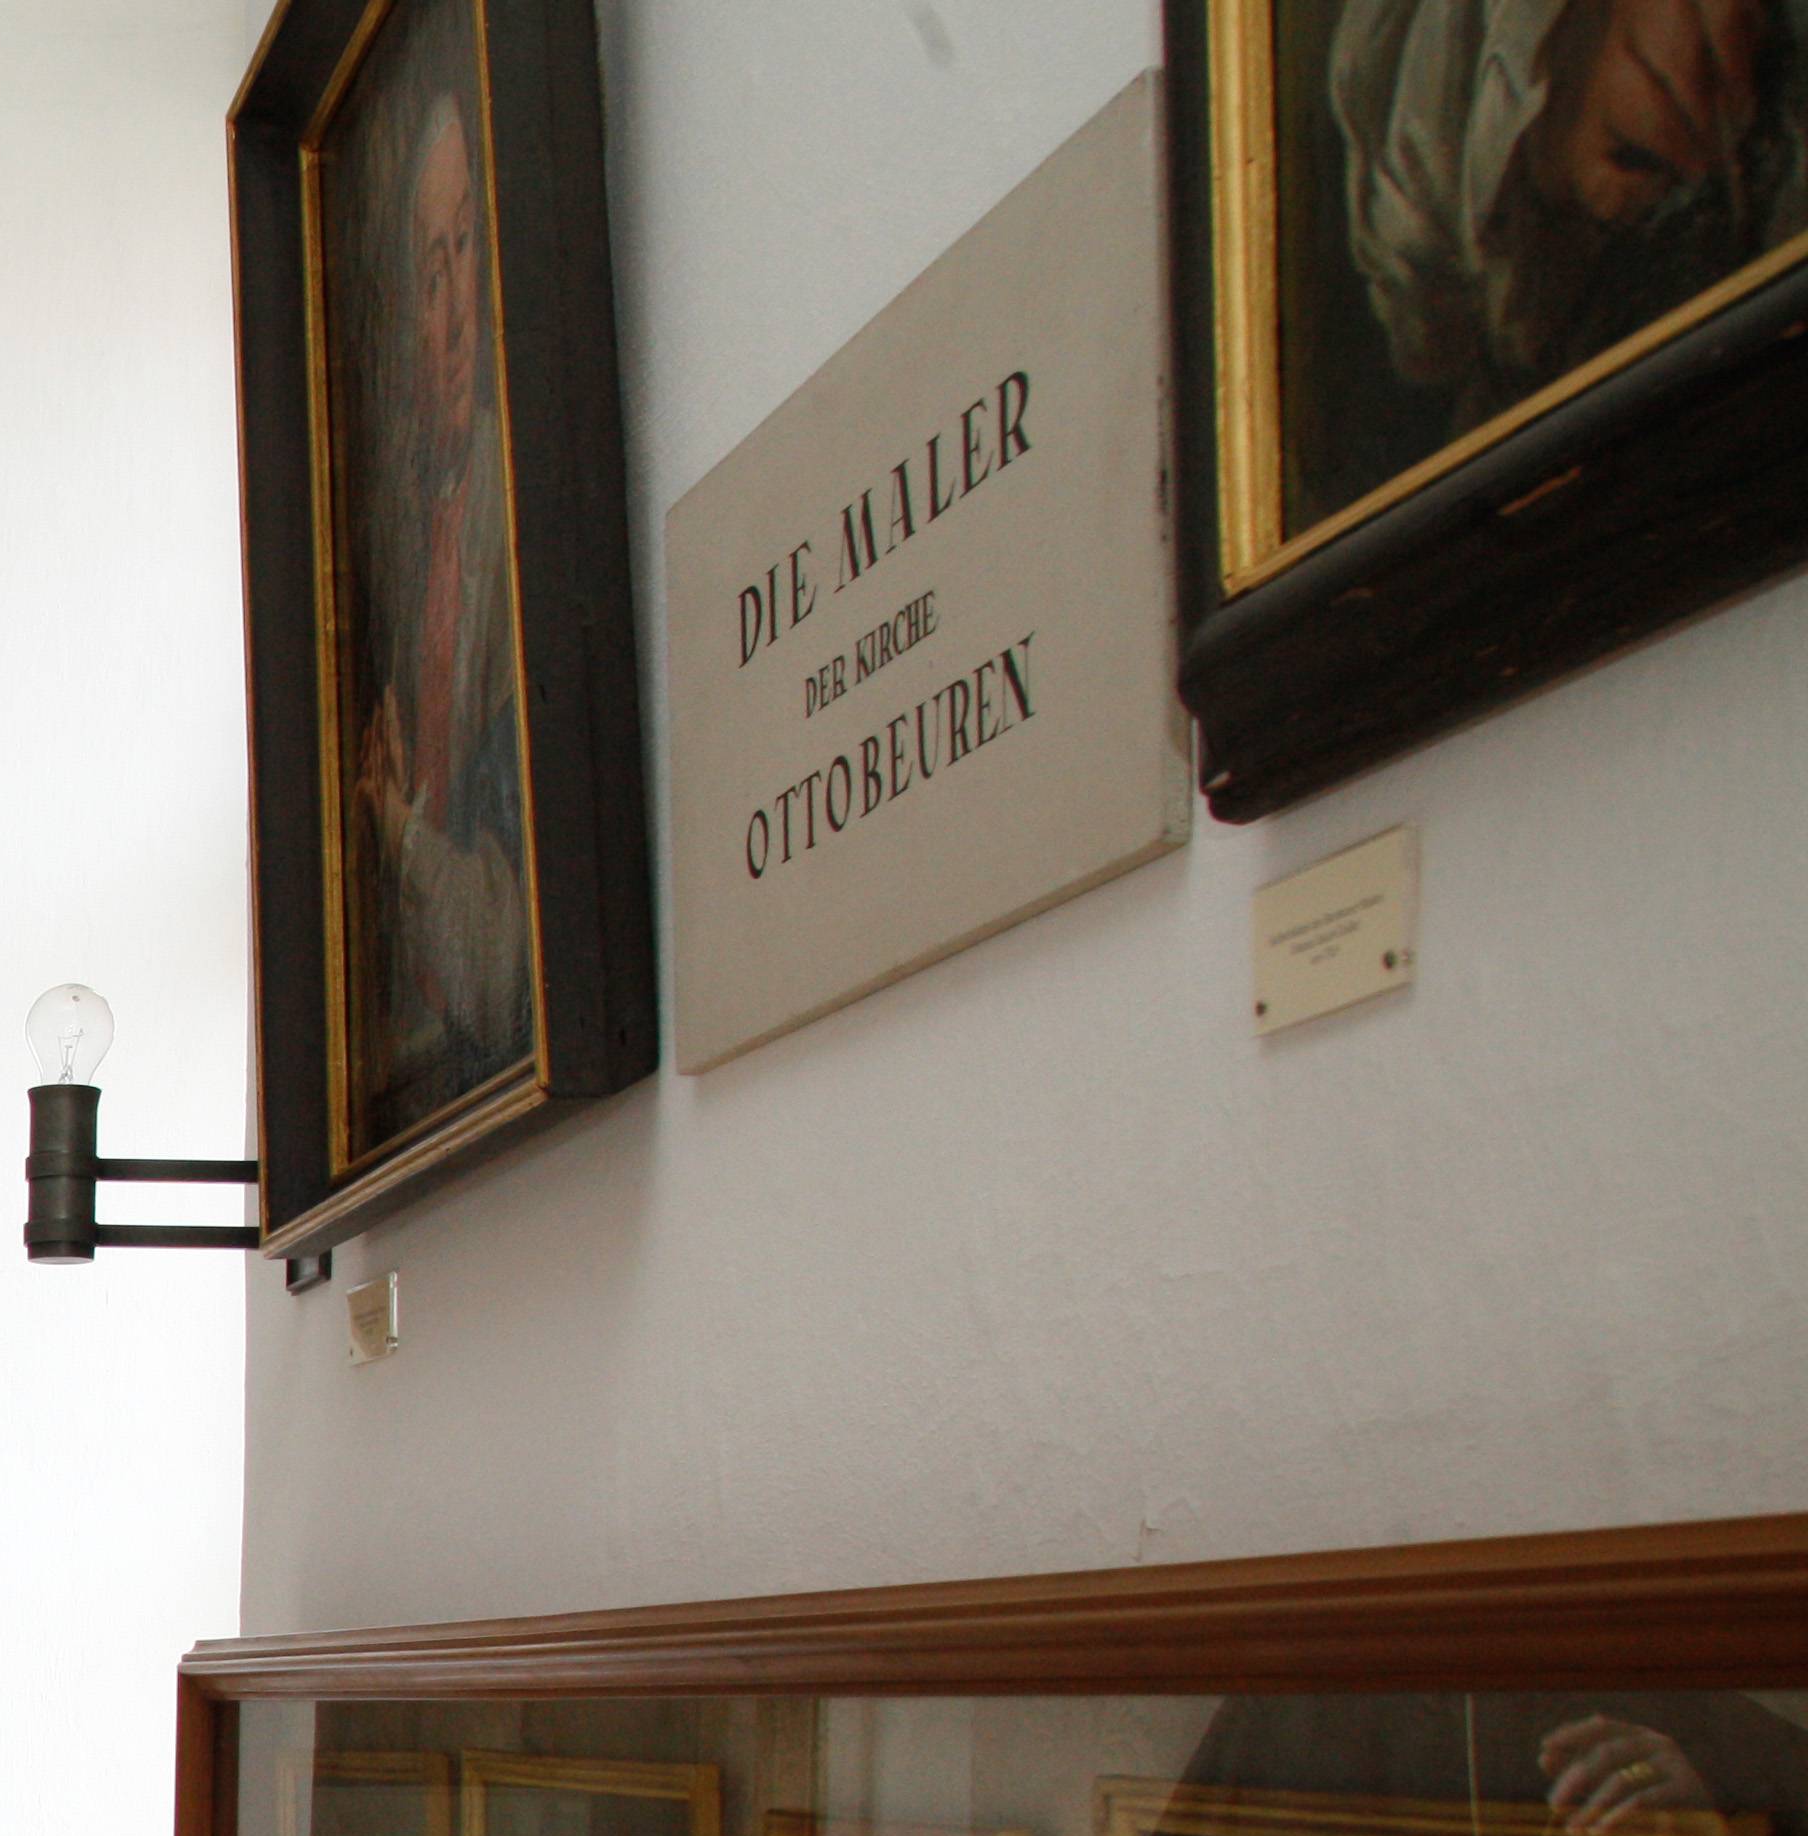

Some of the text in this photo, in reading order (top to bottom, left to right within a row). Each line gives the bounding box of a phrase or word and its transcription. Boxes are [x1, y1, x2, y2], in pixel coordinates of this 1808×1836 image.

[737, 370, 1032, 669] DIE MALER
[746, 631, 1037, 880] OTTOBEUREN
[805, 589, 940, 720] DER KIRCHE
